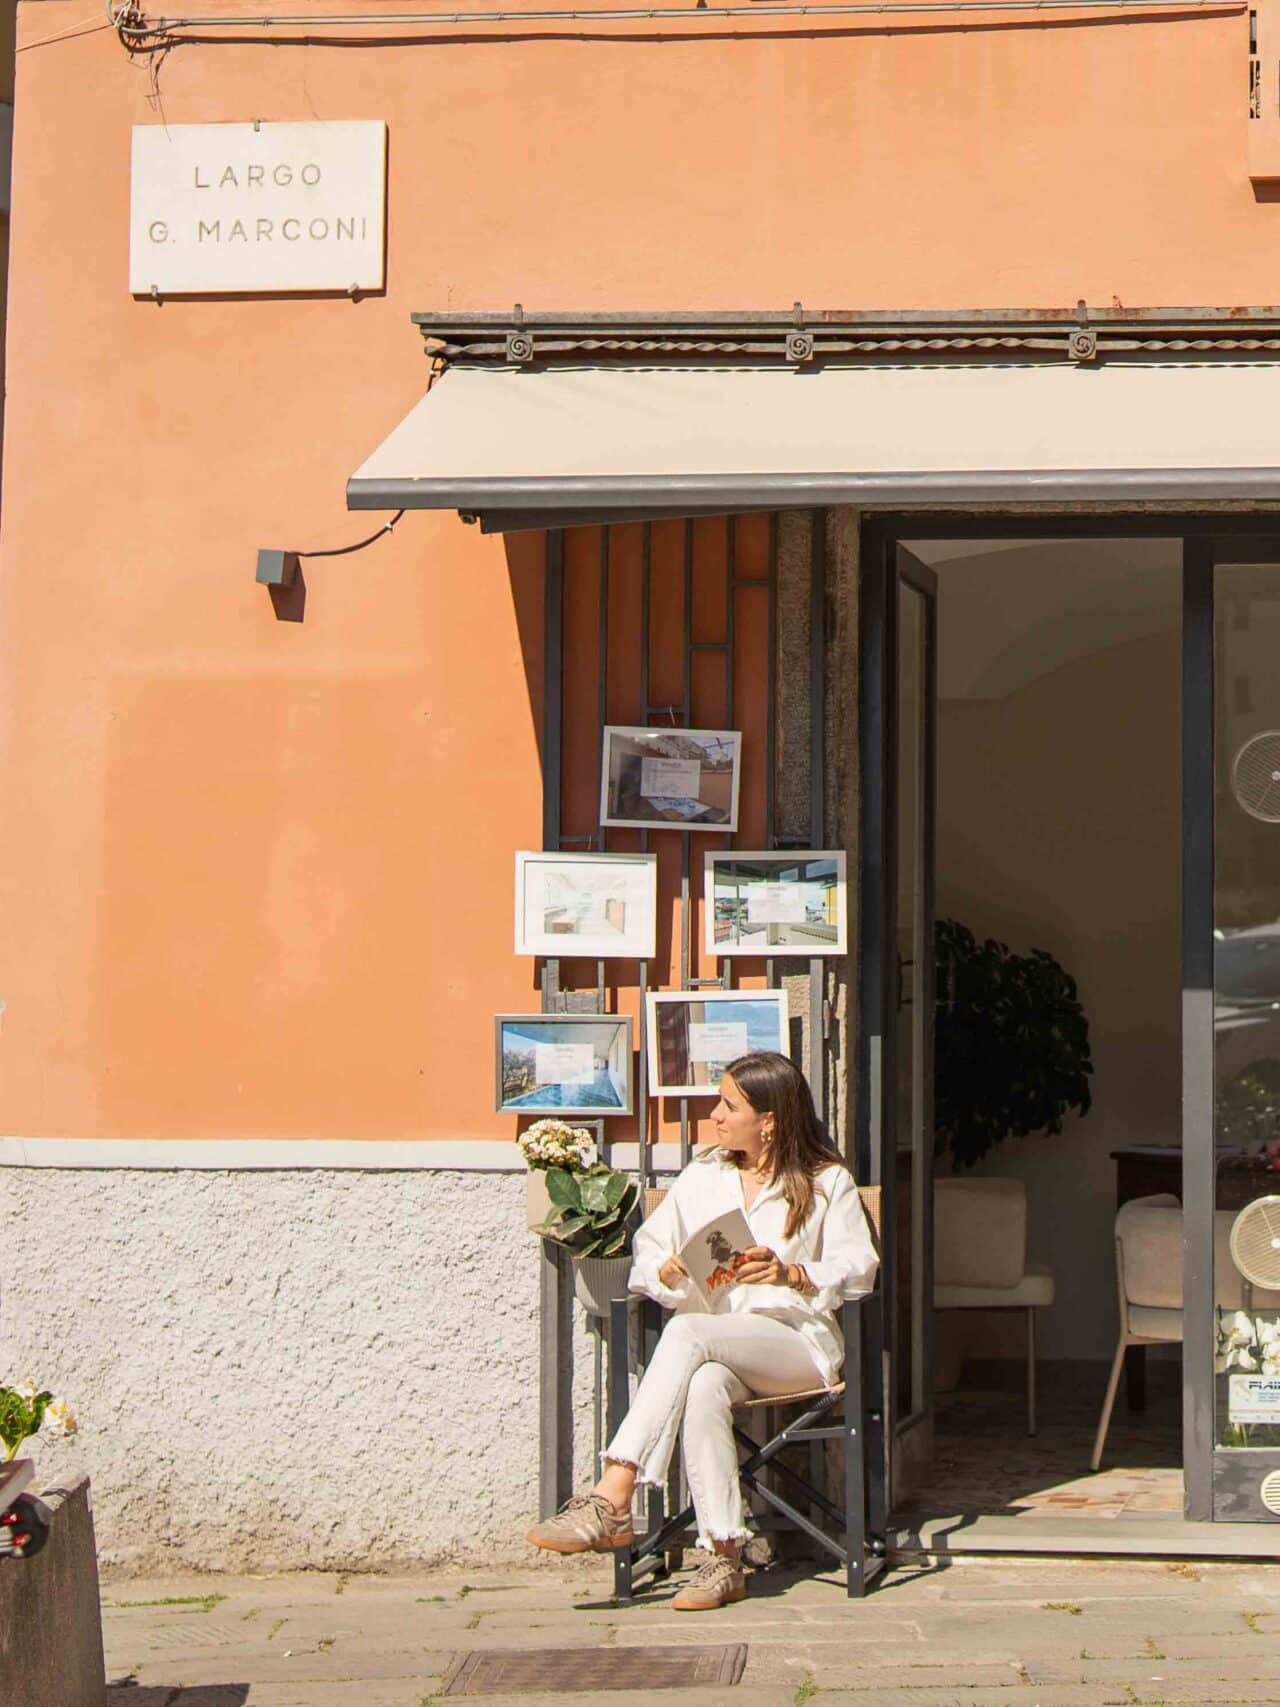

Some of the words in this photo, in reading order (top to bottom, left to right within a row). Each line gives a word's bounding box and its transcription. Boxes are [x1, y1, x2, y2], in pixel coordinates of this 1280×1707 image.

[194, 163, 322, 189] LARGO
[148, 220, 176, 244] G.
[198, 217, 367, 243] MARCONI
